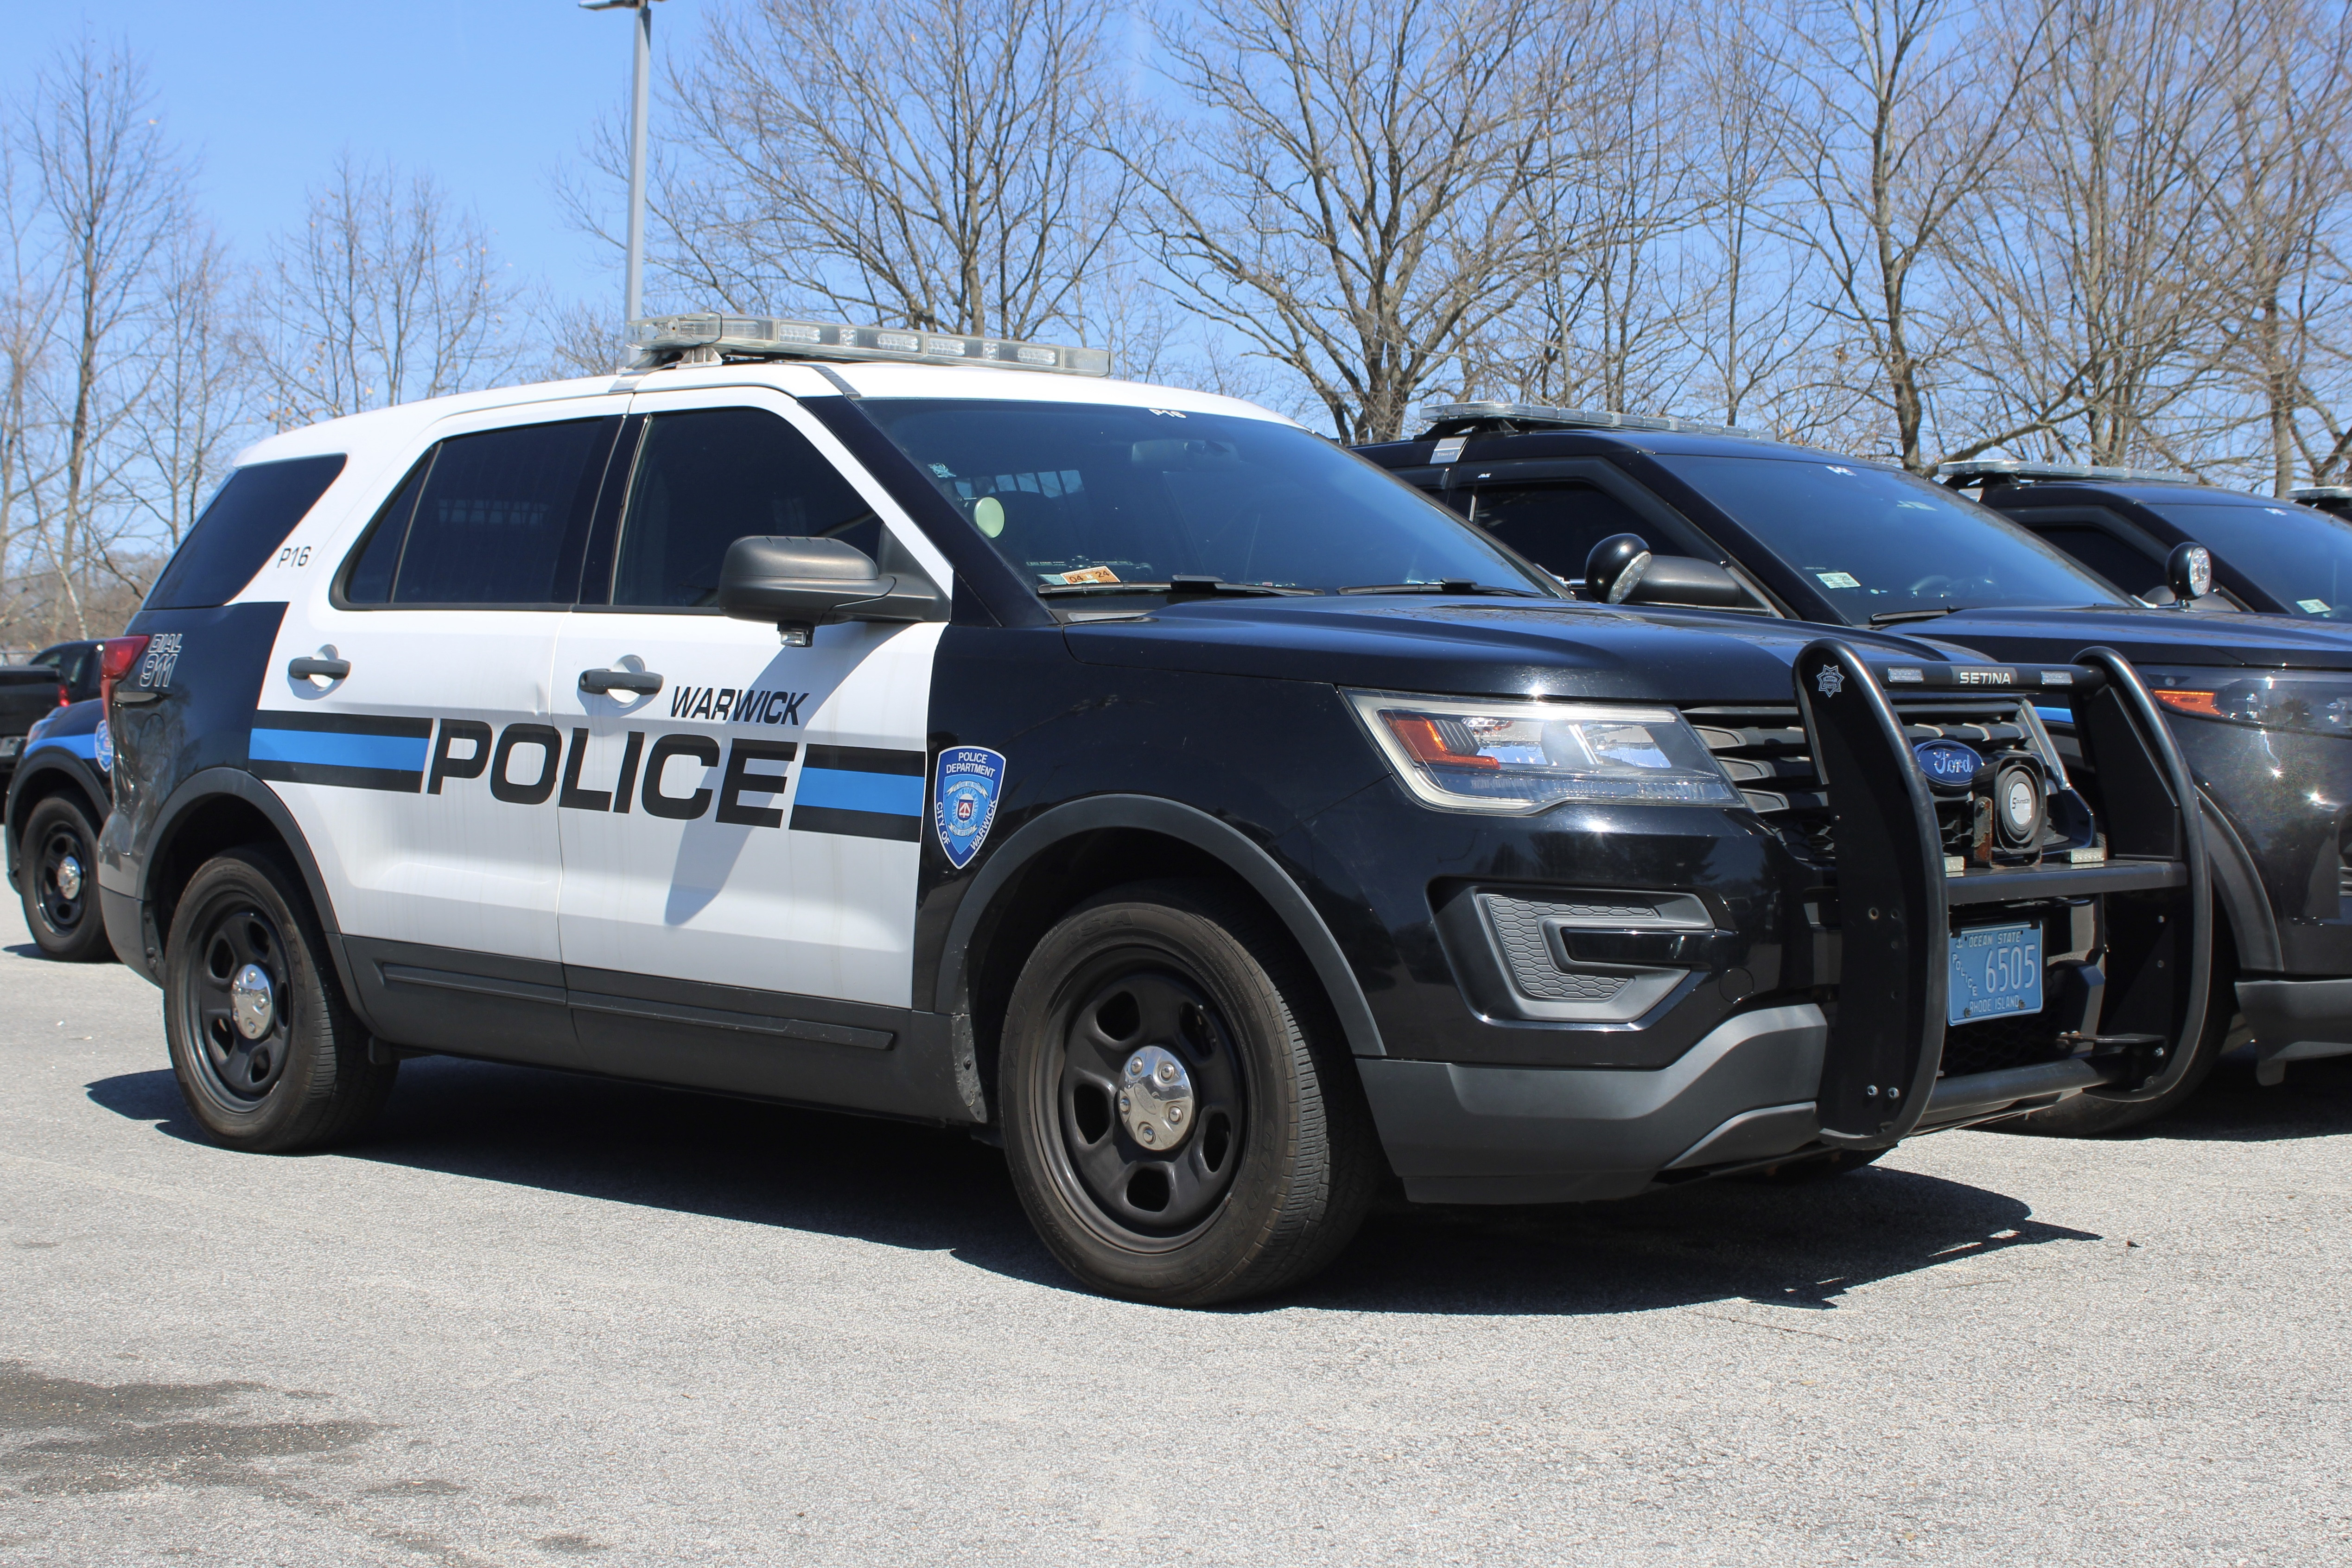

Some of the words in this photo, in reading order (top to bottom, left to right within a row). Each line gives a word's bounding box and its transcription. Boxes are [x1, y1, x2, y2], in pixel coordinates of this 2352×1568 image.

[1149, 409, 1187, 419] P16
[277, 546, 311, 568] P16
[147, 634, 183, 653] DIAL
[139, 653, 178, 687] 911
[1959, 671, 2011, 685] SETINA
[670, 686, 809, 725] WARWICK
[958, 752, 988, 764] POLICE
[1933, 749, 1974, 774] Ford
[427, 718, 798, 828] POLICE
[946, 762, 996, 778] DEPARTMENT
[936, 801, 945, 827] CITY
[941, 832, 951, 845] OF
[970, 799, 996, 851] WARWICK
[1969, 933, 1992, 948] OCEAN
[1997, 931, 2021, 944] STATE
[1952, 952, 1978, 996] POLICE
[1985, 944, 2035, 993] 6505
[1970, 998, 1991, 1013] RHODE
[1995, 994, 2020, 1010] ISLAND
